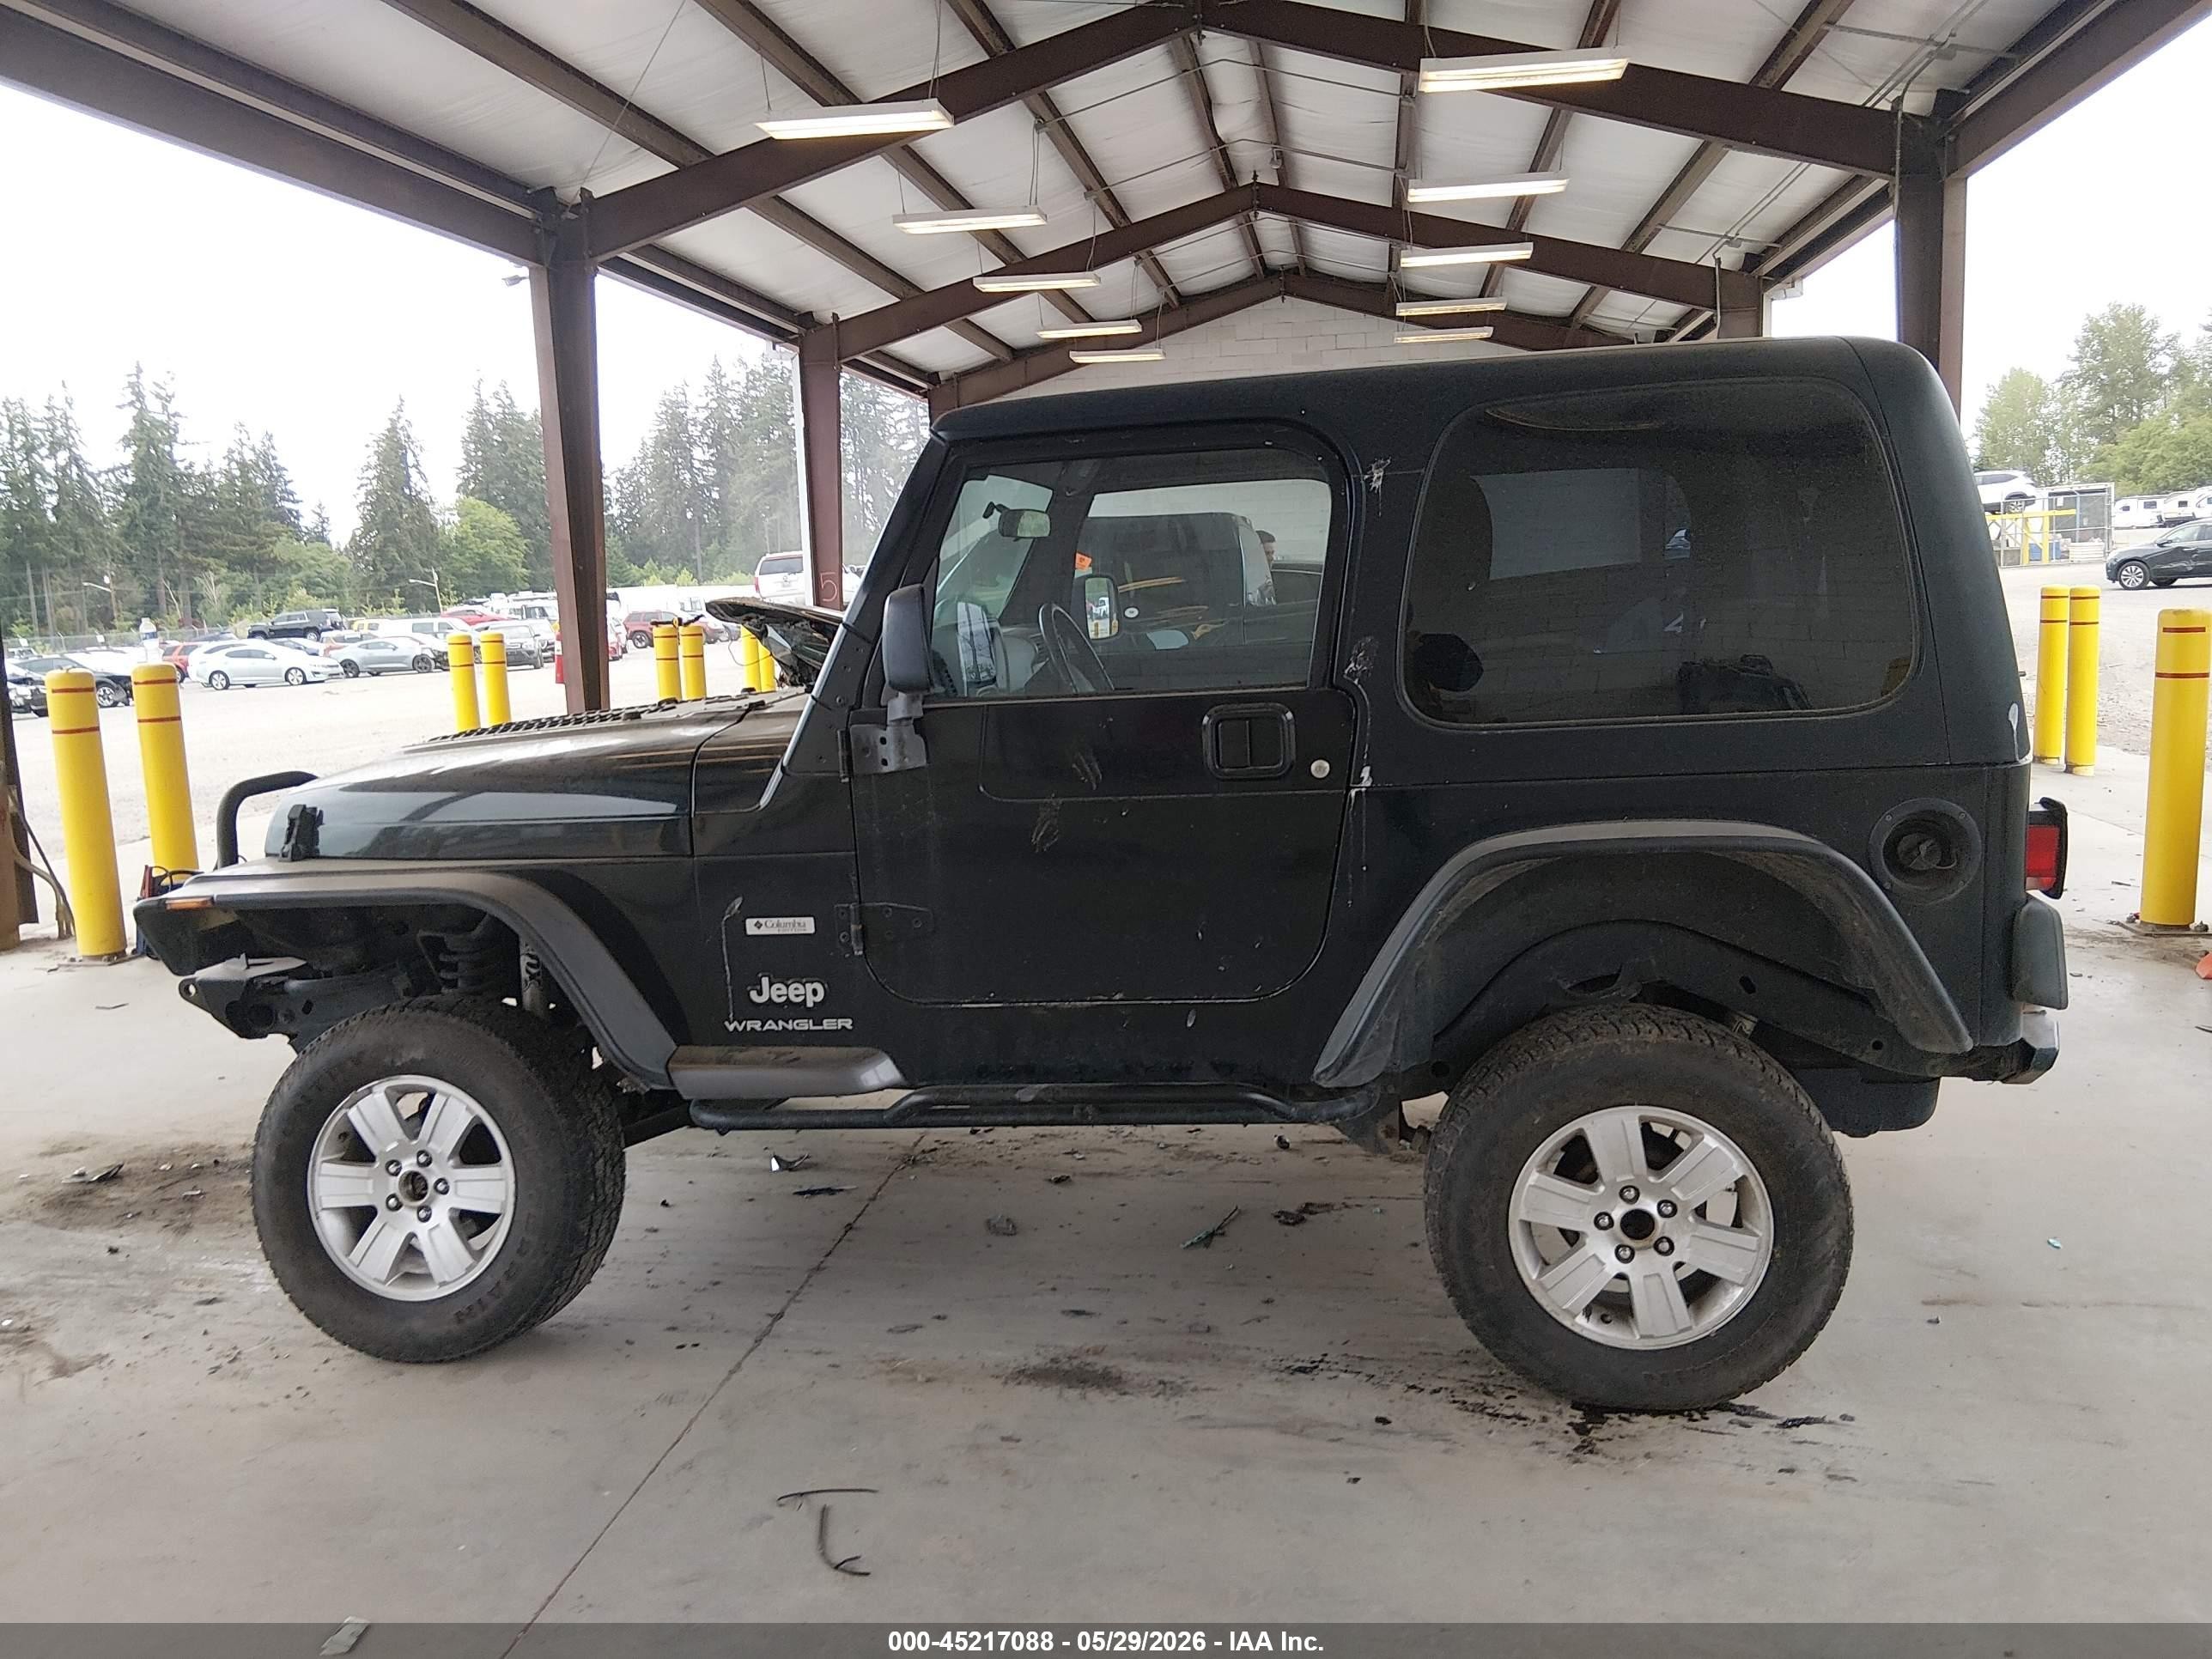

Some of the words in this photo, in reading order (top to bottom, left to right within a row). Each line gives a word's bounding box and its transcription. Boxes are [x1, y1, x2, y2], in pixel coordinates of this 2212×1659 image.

[819, 571, 838, 602] 5
[749, 976, 825, 1008] Jeep
[724, 1018, 854, 1032] WRANGLER
